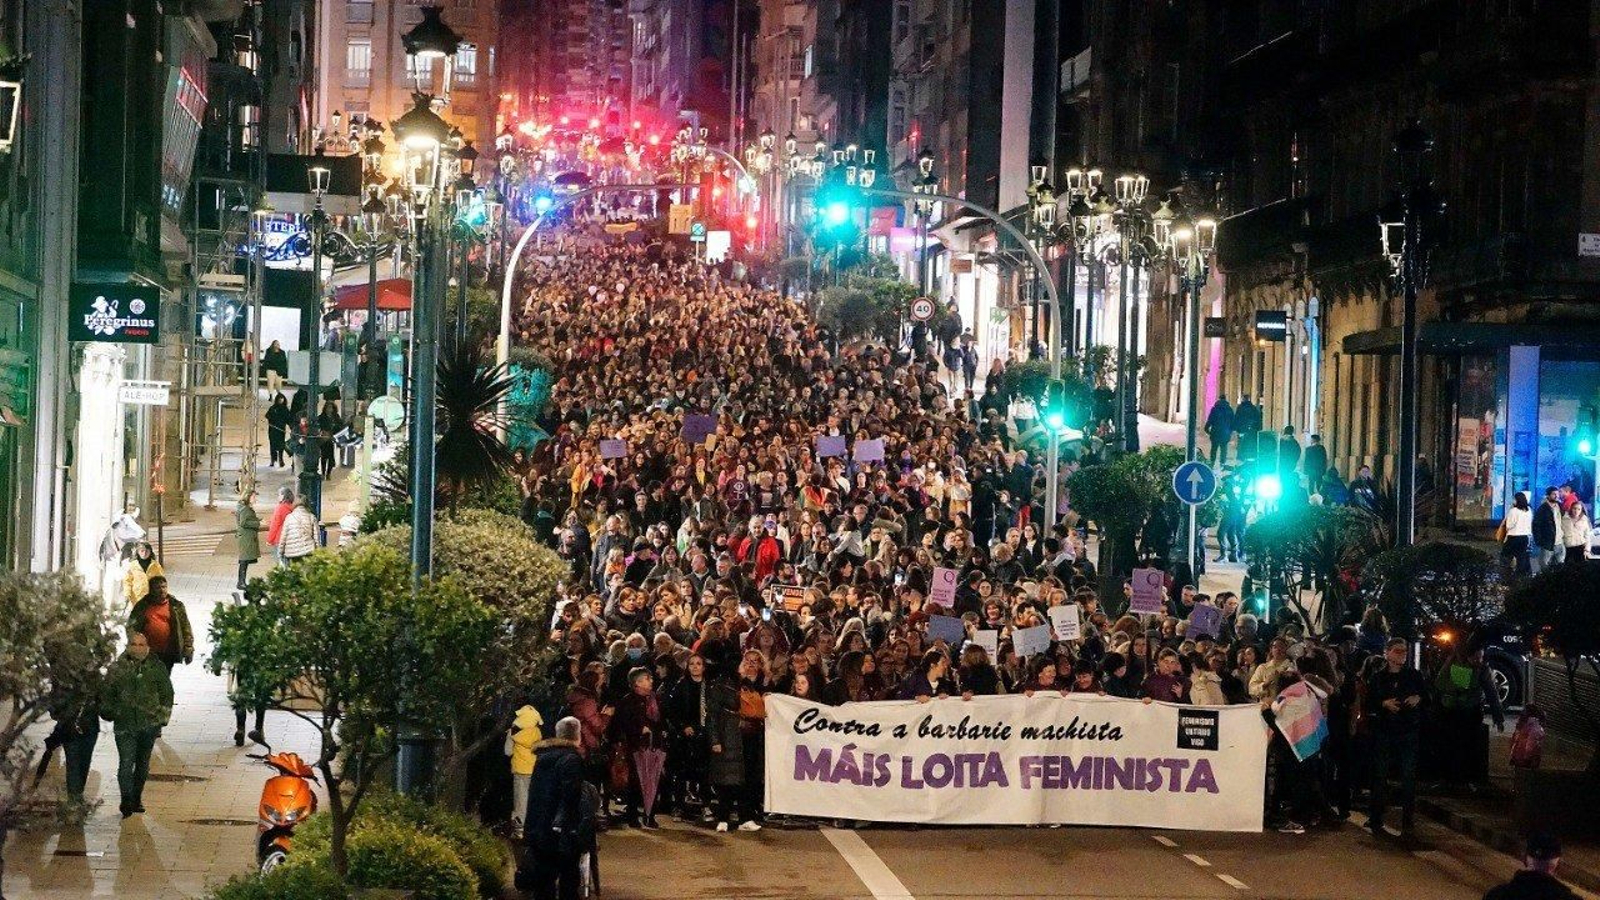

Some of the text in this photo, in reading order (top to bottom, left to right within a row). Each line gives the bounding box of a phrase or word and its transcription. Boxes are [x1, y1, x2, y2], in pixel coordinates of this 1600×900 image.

[916, 305, 930, 313] 40
[84, 314, 155, 330] Peregrinus
[124, 390, 166, 401] ALE-HOP
[794, 708, 1124, 742] Contra a barbarie machista
[794, 742, 1220, 794] MÁIS LOITA FEMINISTA
